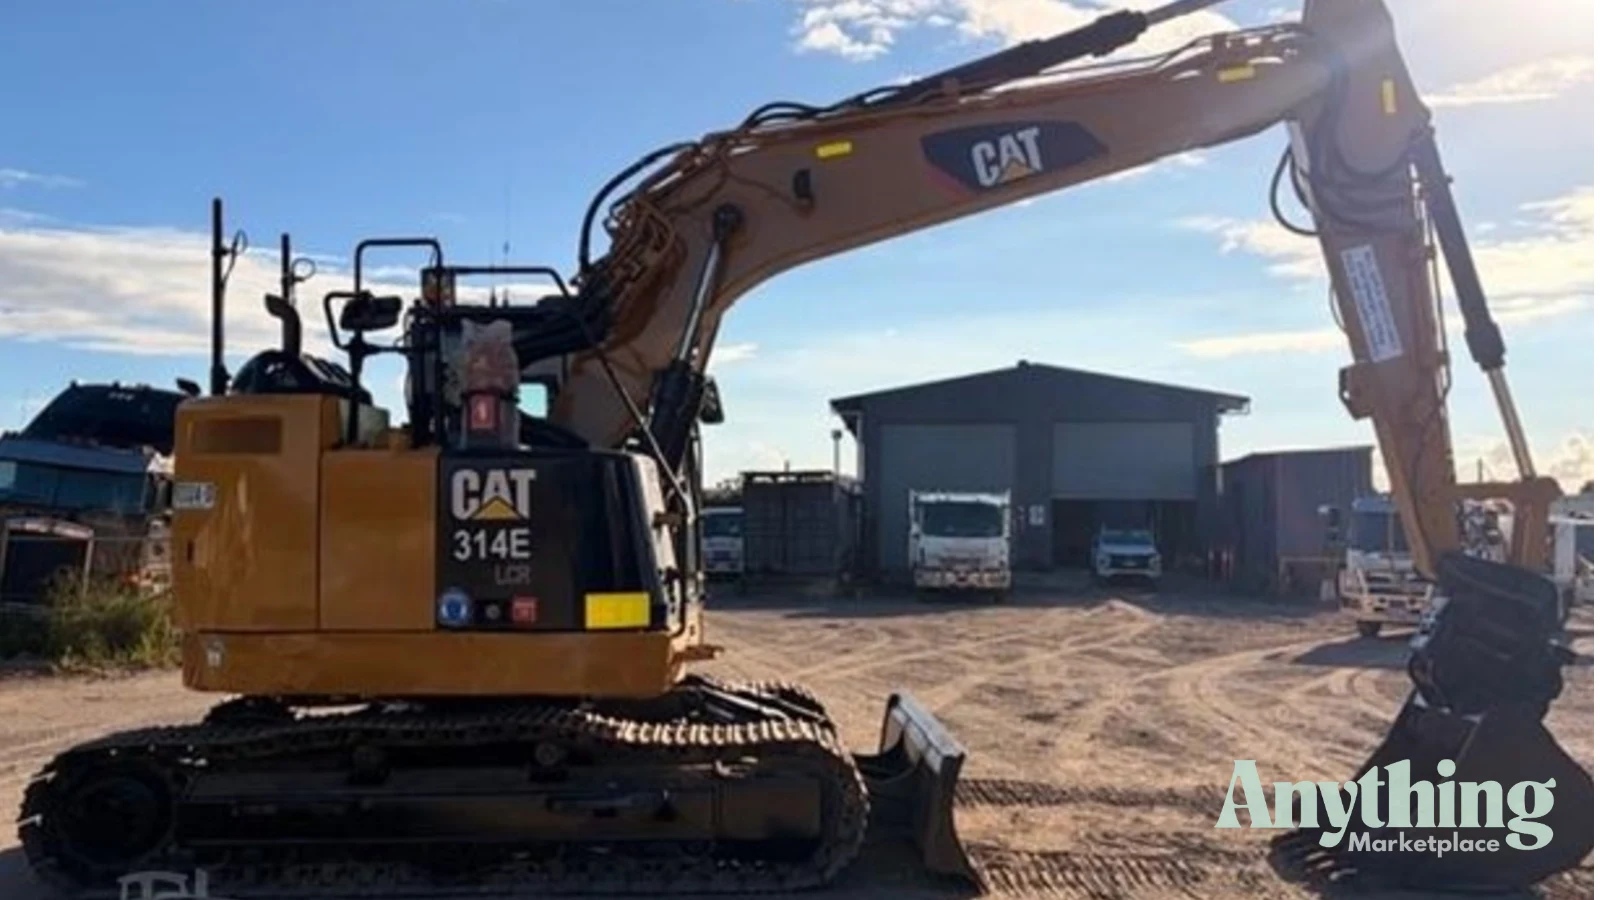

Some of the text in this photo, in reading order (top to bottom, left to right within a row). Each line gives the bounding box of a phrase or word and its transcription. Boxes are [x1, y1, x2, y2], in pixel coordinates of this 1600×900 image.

[971, 126, 1043, 188] CAT
[451, 468, 537, 521] CAT
[453, 527, 531, 561] 314E
[493, 565, 531, 585] LCR
